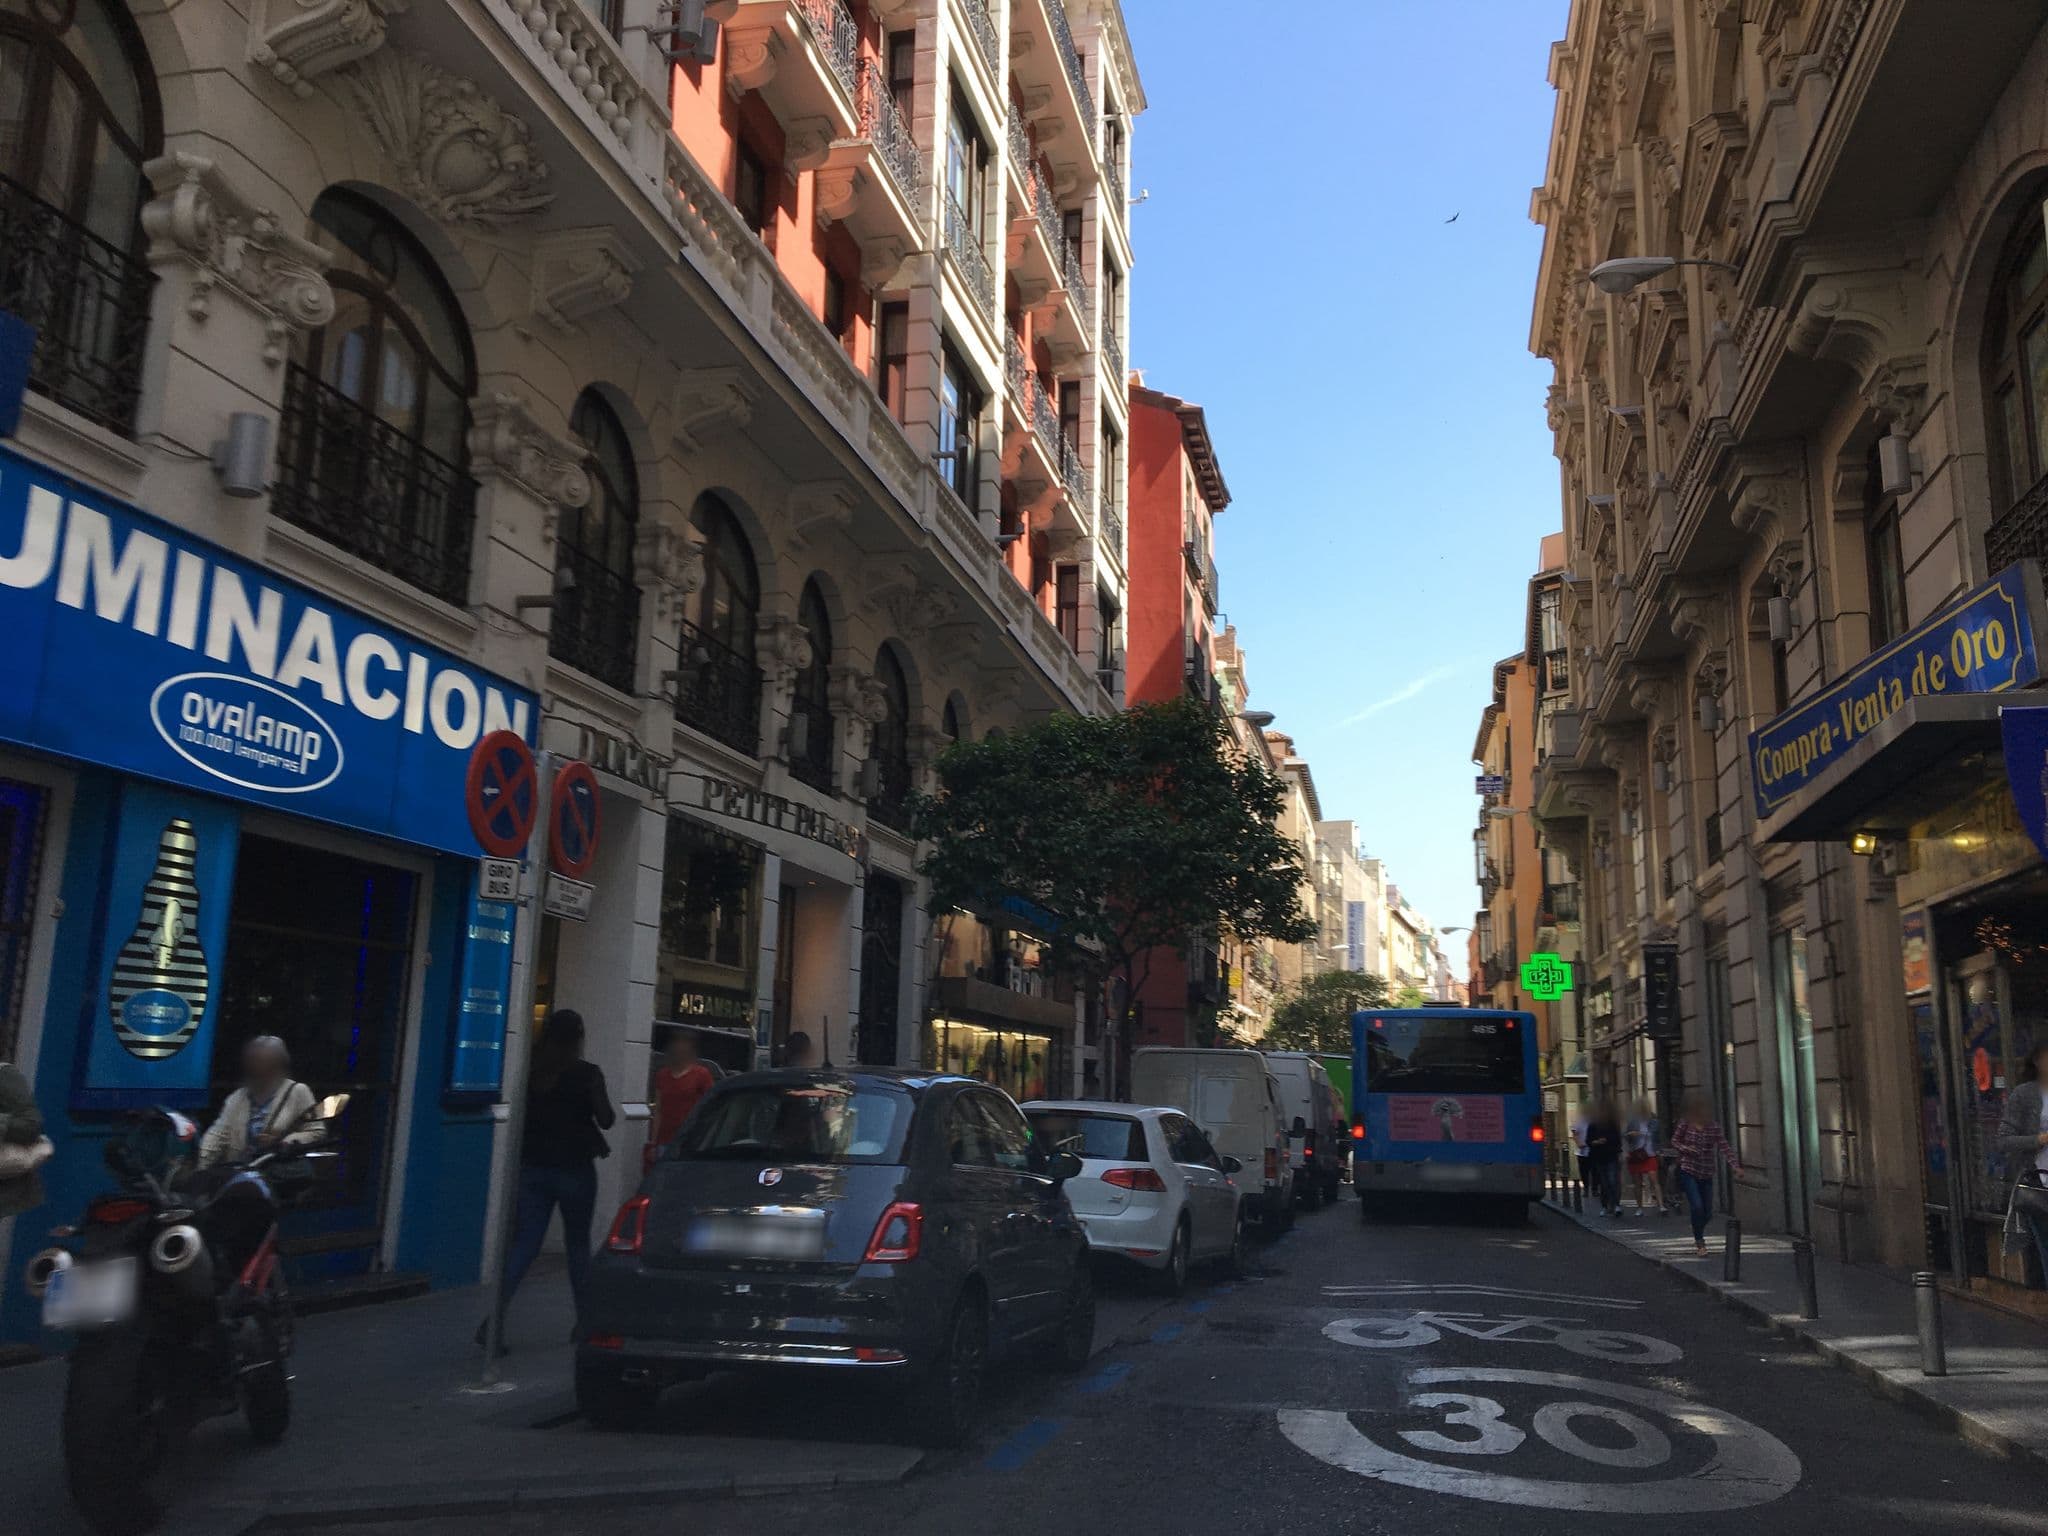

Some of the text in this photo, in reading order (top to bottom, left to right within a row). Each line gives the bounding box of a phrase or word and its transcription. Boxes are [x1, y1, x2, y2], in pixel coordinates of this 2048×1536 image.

[1758, 620, 2005, 785] Compra-Venta de Oro
[488, 880, 510, 895] BUS
[1397, 1393, 1671, 1467] 30
